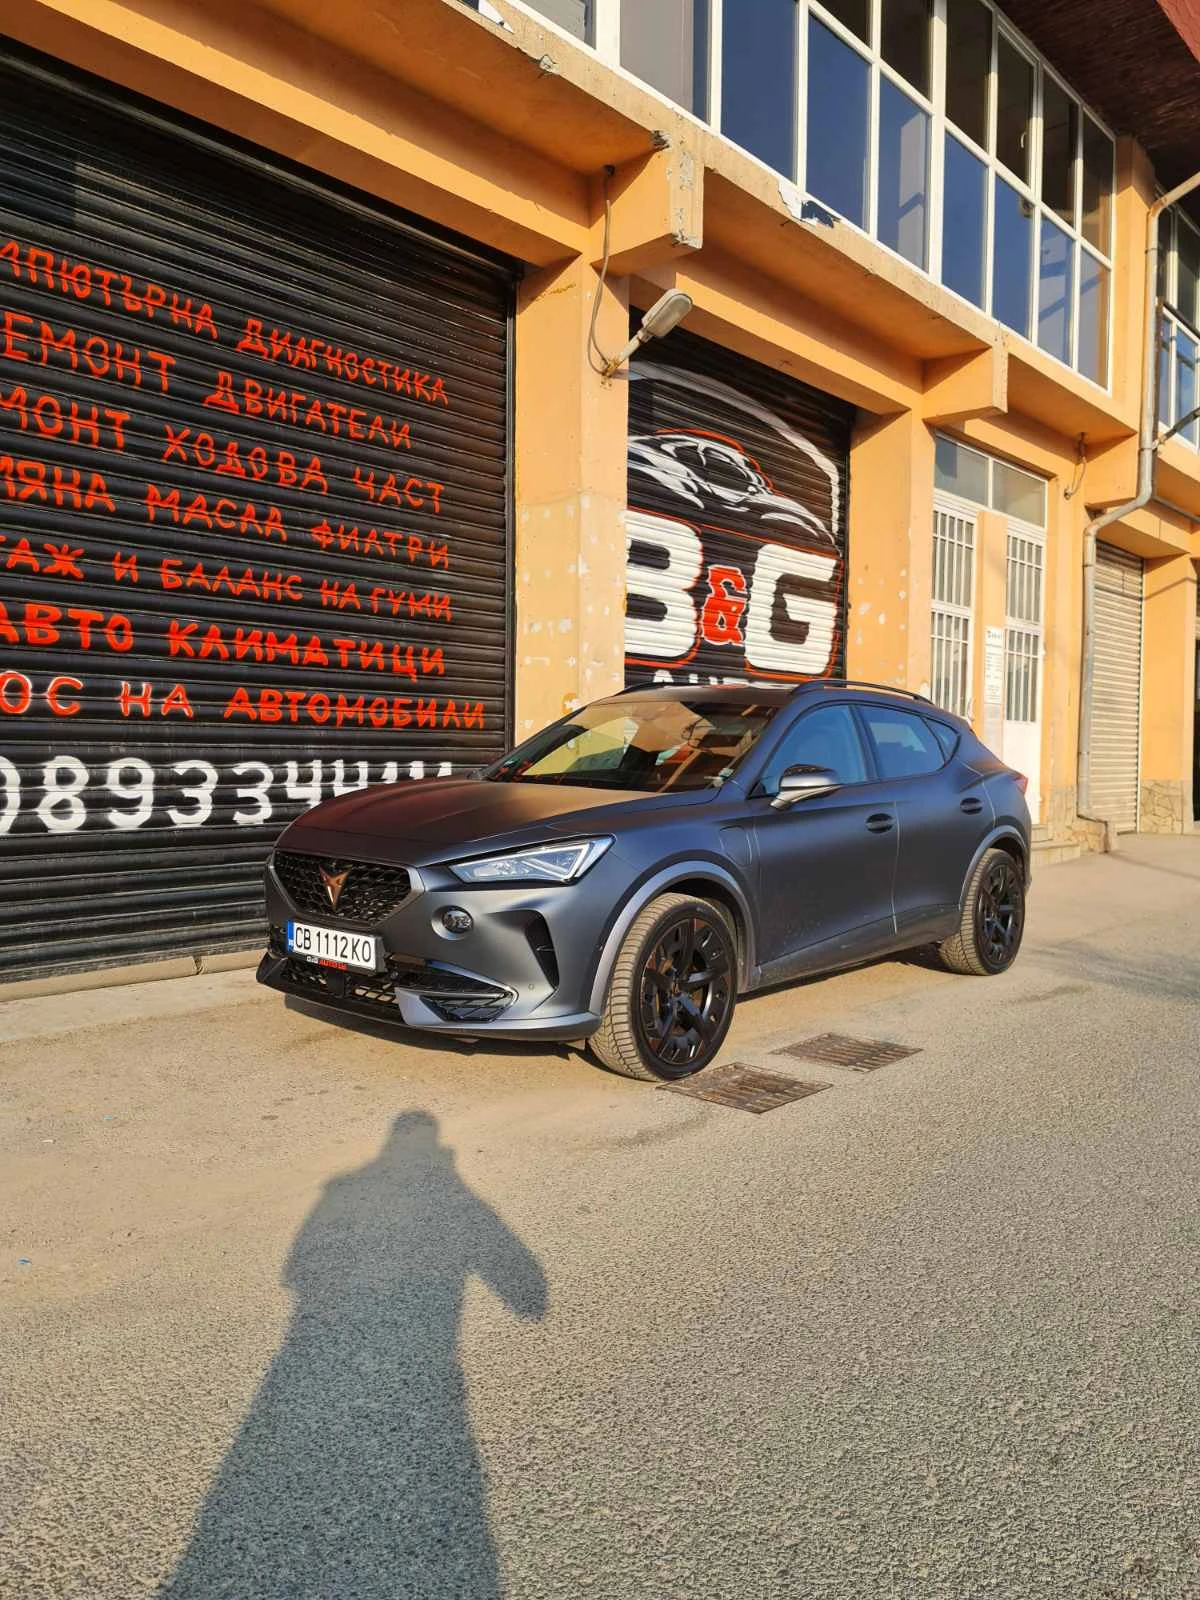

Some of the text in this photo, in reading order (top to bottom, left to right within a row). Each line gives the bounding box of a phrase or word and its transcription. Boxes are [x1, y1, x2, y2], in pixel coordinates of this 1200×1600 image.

[4, 312, 410, 448] ЕМОНТ ДВИГАТЕЛИ
[236, 319, 448, 403] ДИАГНОСТИКА
[164, 426, 327, 494] ХОДОВА
[353, 466, 443, 512] ЧАСТ
[145, 485, 286, 540] МАСЛА
[311, 521, 448, 568] ФИЛТРИ
[0, 535, 451, 620] АЖ И БАЛАНС НА ГУМИ
[167, 621, 444, 682] КЛИМАТИЦИ
[118, 683, 193, 717] НА
[224, 688, 484, 728] АВТОМОБИЛИ
